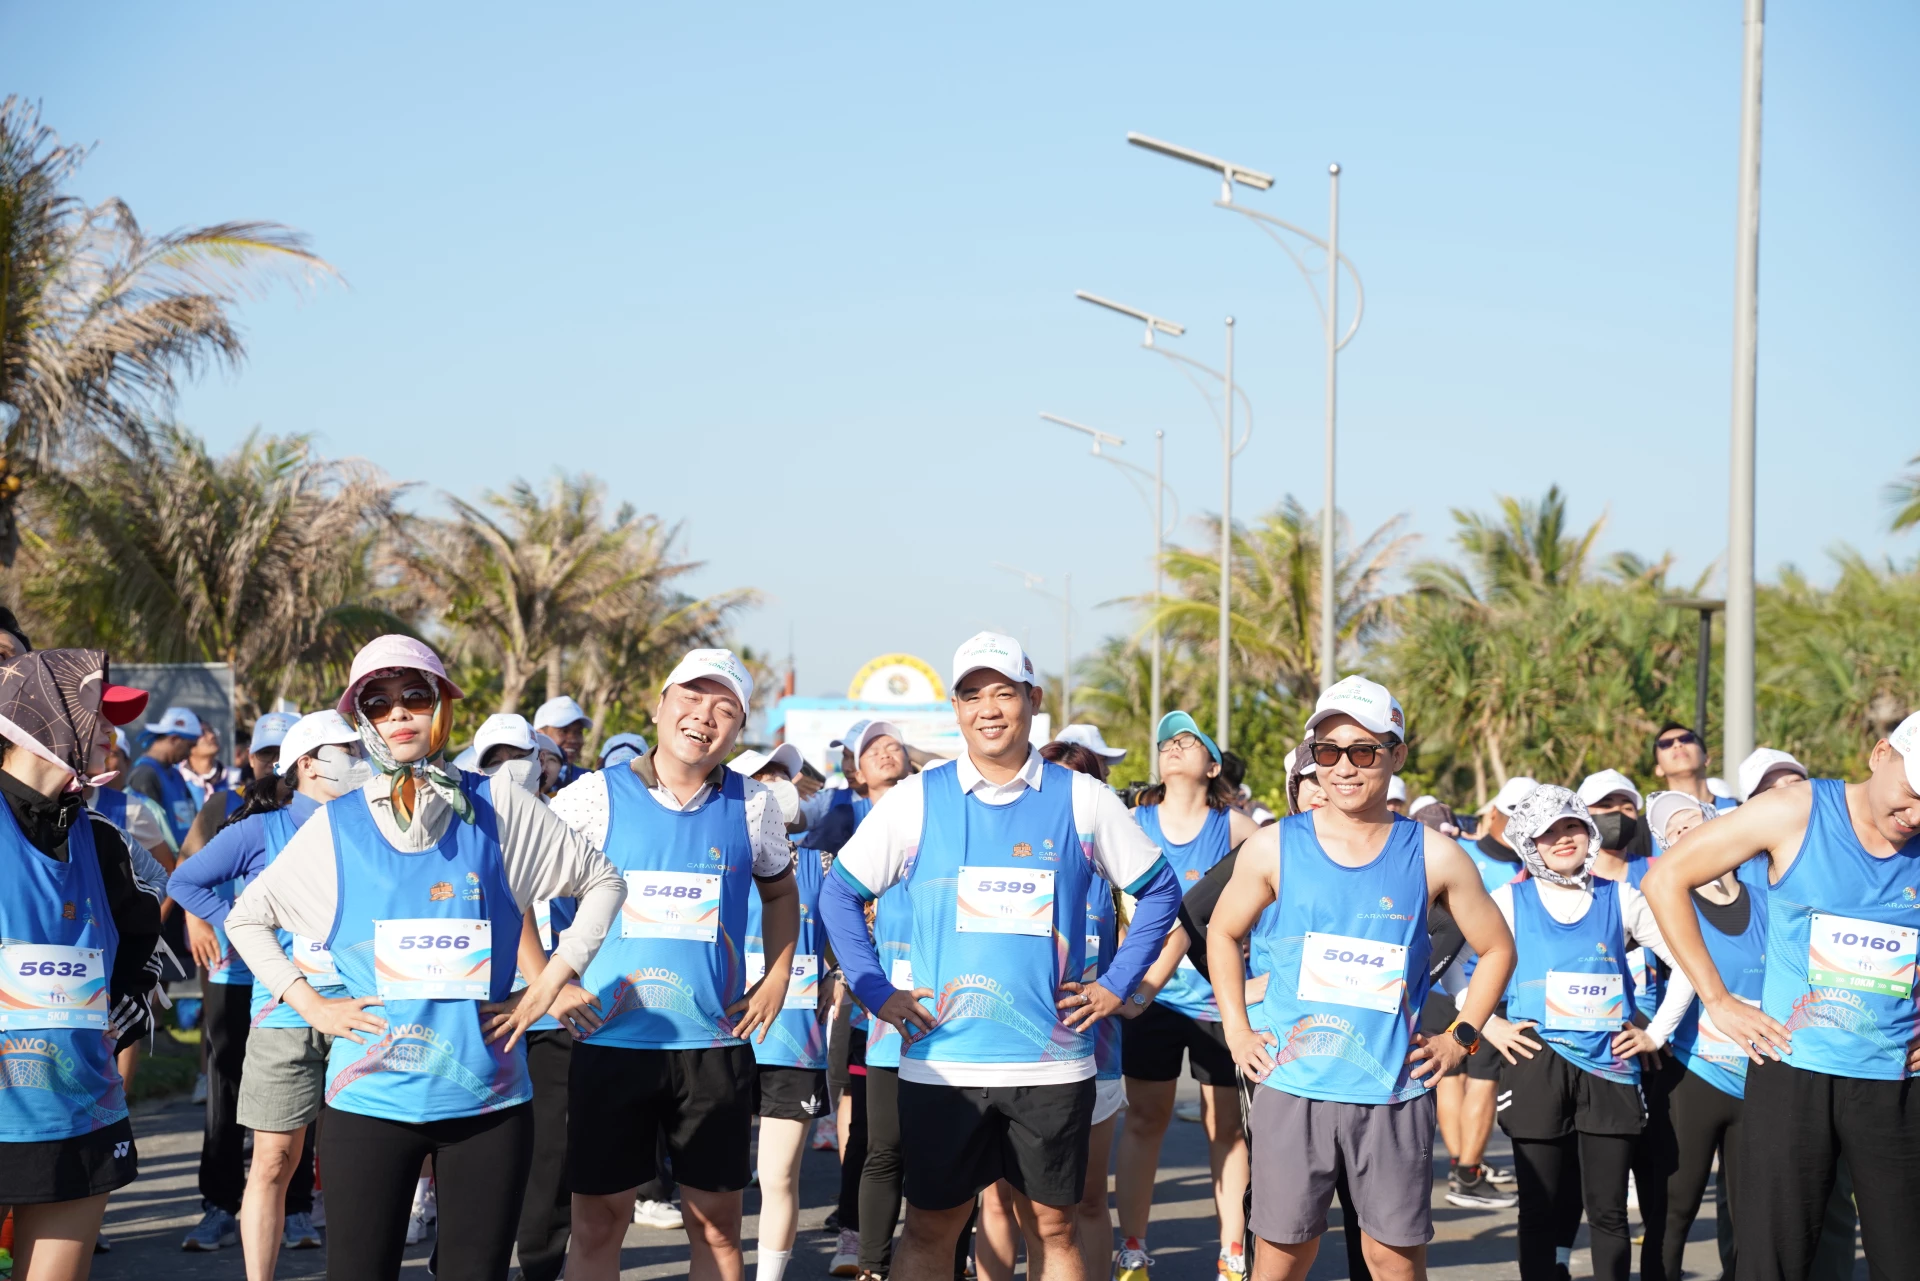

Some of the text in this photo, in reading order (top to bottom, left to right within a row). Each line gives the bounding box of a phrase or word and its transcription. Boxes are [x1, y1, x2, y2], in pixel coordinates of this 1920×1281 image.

[988, 648, 1009, 657] XANH
[727, 669, 743, 683] XANH
[1352, 694, 1374, 705] XANH
[642, 884, 703, 900] 5488
[977, 880, 1036, 895] 5399
[398, 935, 471, 950] 5366
[1830, 930, 1902, 953] 10160
[1322, 948, 1385, 968] 5044
[19, 961, 87, 977] 5632
[613, 967, 694, 1000] CARAWORLD
[1567, 984, 1608, 996] 5181
[1848, 977, 1876, 988] 10KM
[47, 1011, 70, 1021] 5KM
[1284, 1013, 1366, 1046] CARAWORLD
